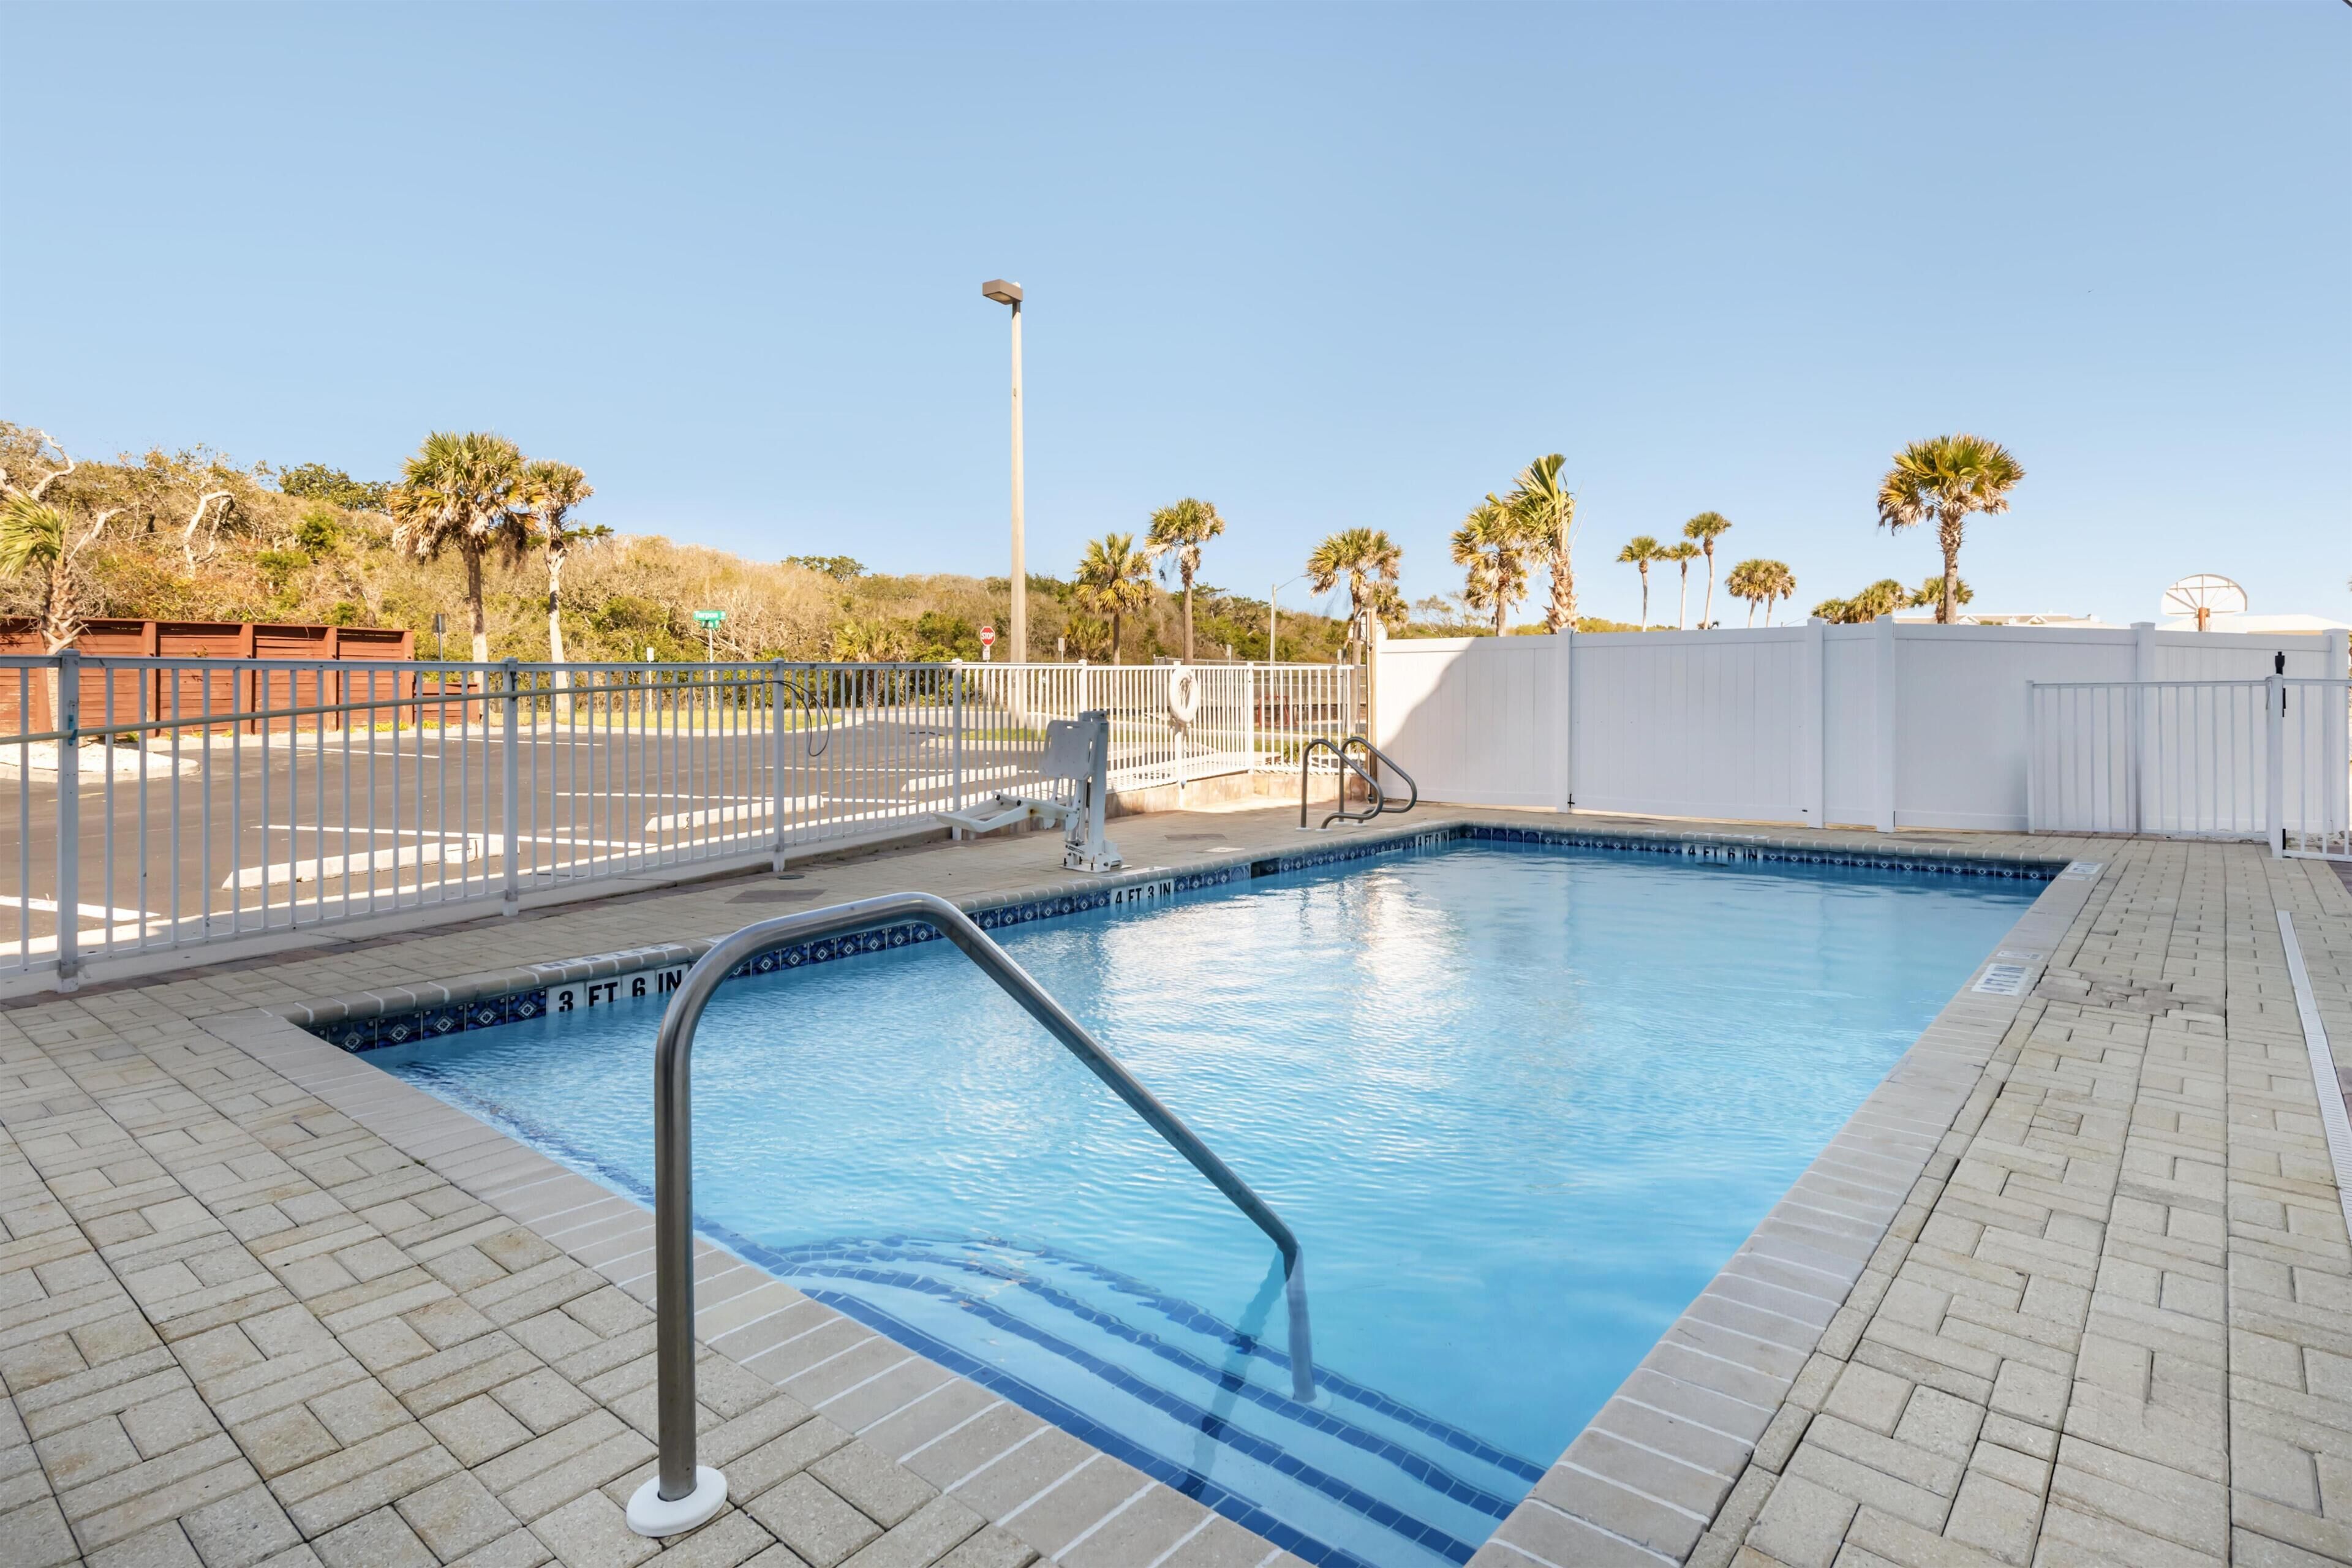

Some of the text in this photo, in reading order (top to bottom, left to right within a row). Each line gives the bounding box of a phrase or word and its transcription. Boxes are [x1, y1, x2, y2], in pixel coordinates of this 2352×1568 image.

[1418, 836, 1422, 846] 4
[1425, 835, 1432, 845] FT
[1441, 831, 1447, 842] IN
[1688, 845, 1696, 856] 4
[1703, 846, 1719, 858] FT
[1743, 848, 1757, 859] IN
[1115, 882, 1170, 903] 4 FT 3 IN
[559, 970, 682, 1012] 3 FT 6 IN
